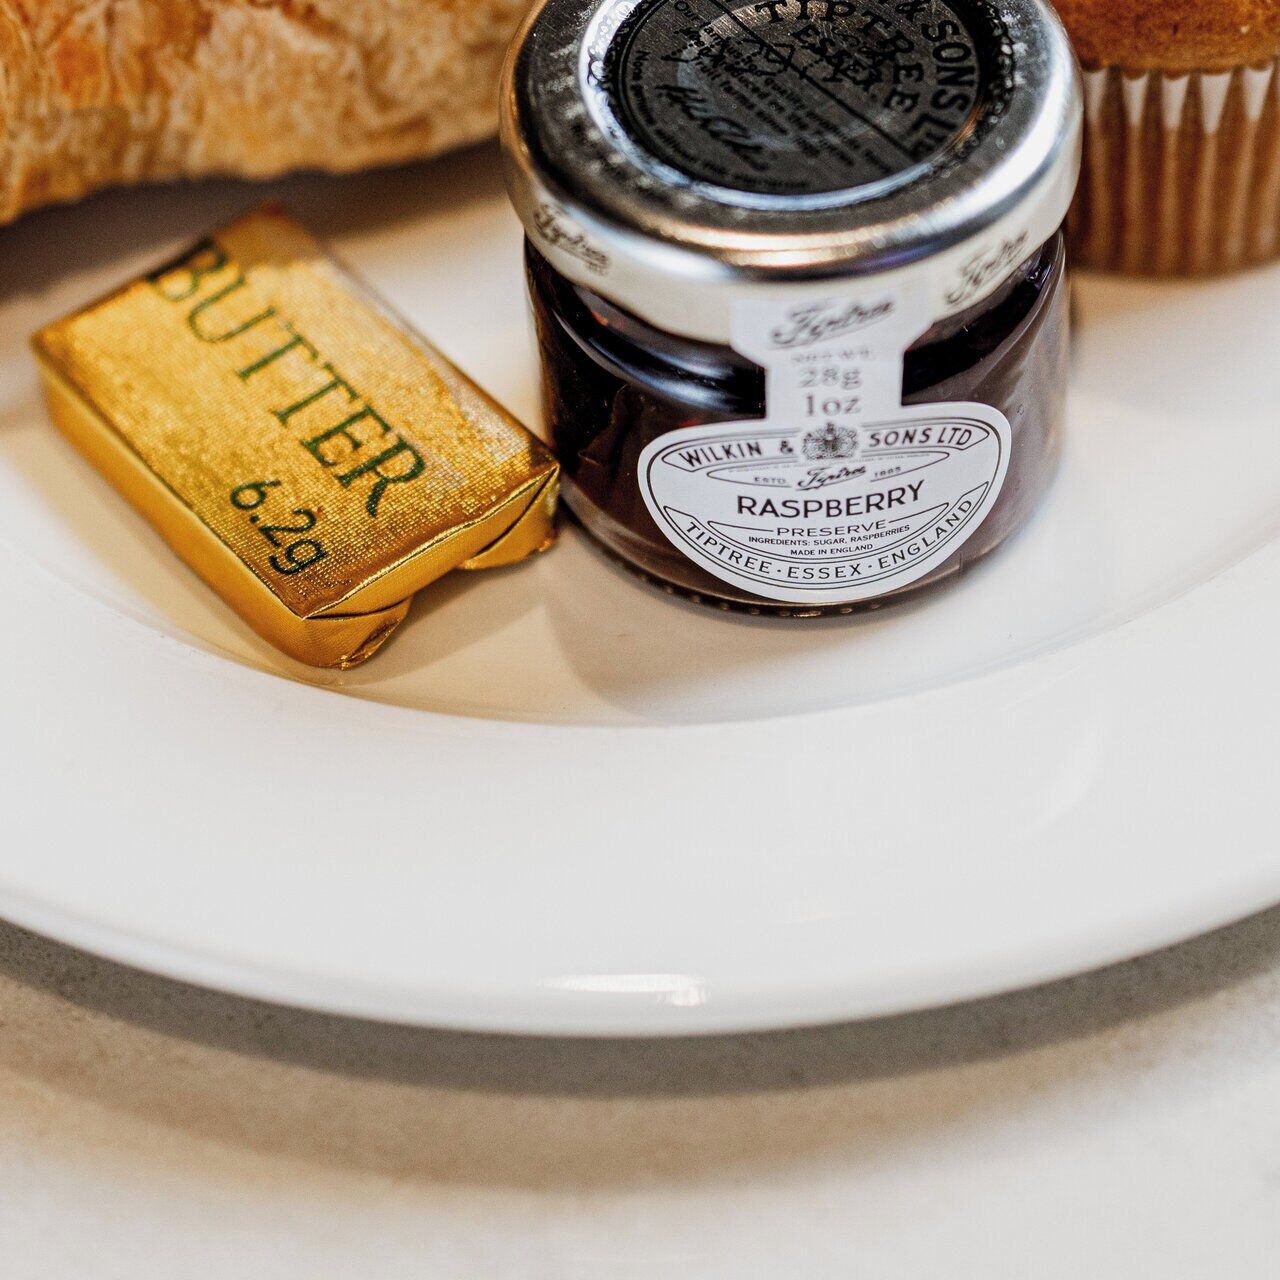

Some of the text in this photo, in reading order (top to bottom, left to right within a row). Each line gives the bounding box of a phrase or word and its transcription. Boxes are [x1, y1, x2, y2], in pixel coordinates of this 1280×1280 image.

[670, 0, 703, 22] Our
[922, 17, 974, 116] SONS
[144, 241, 428, 519] BUTTER
[799, 367, 863, 391] 28g
[805, 393, 862, 417] 1oz
[678, 441, 763, 468] WILKIN
[779, 439, 794, 455] &
[870, 427, 933, 448] SONS
[937, 426, 973, 446] LTD
[736, 479, 925, 519] RASPBERRY
[229, 478, 329, 576] 6.2g
[685, 499, 973, 581] TIPTREE ESSEX ENGLAND
[748, 524, 910, 547] INGREDIENTS: SUGAR, RASPBERRIES
[776, 519, 887, 537] PRESERVE
[790, 543, 874, 556] MADE IN ENGLAND
